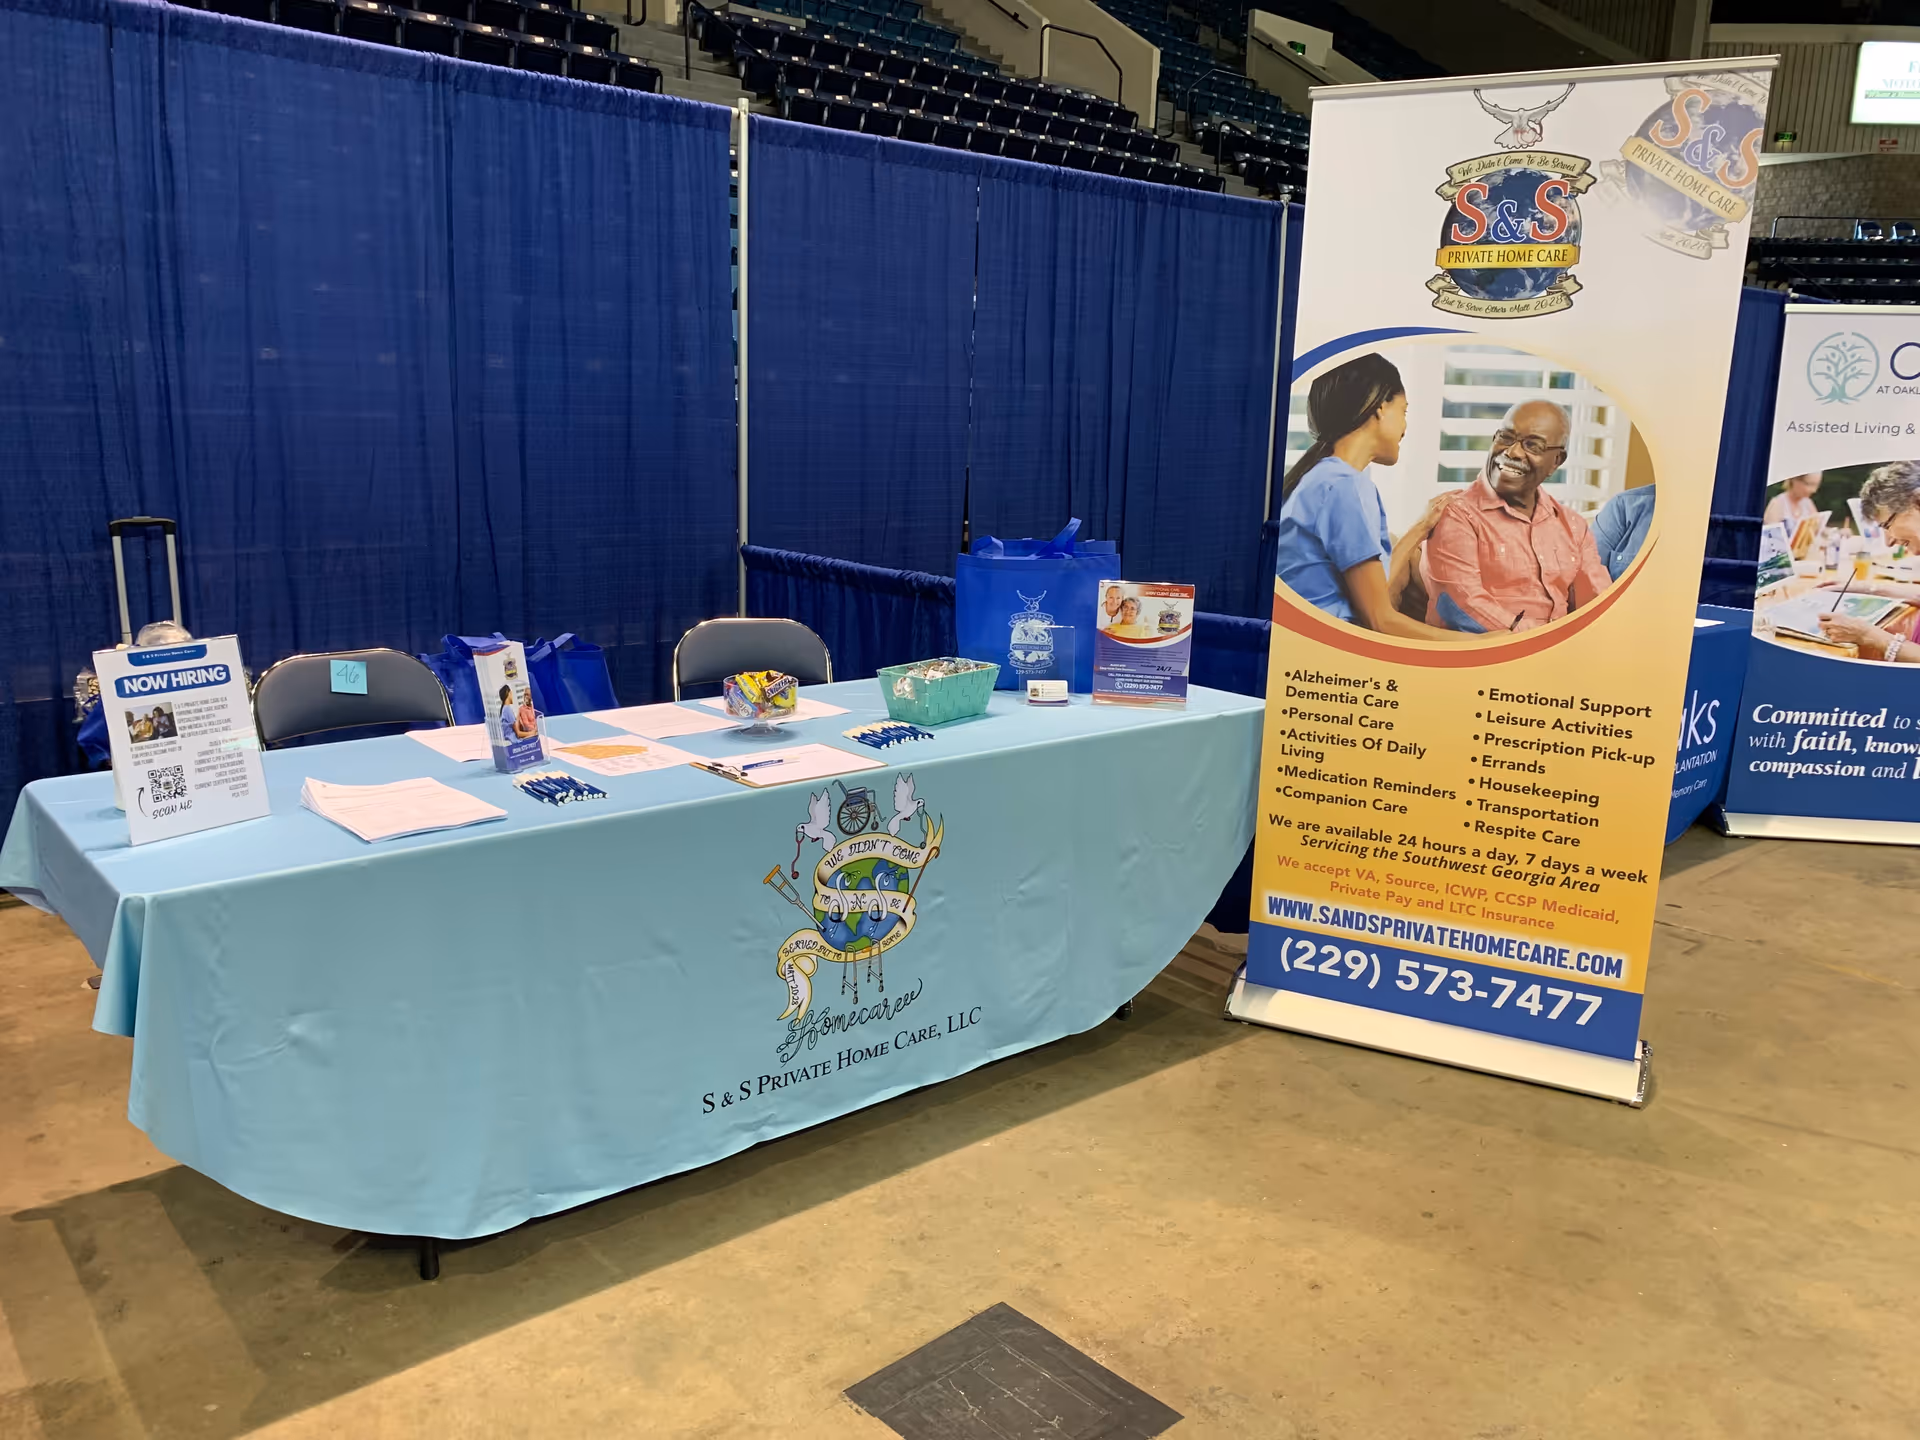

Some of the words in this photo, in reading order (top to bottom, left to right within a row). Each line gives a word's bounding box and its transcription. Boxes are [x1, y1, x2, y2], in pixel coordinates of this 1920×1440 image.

[1458, 166, 1473, 177] We
[1475, 157, 1501, 172] Didn't
[1503, 155, 1524, 167] Come
[1537, 156, 1549, 167] Be
[1551, 158, 1577, 172] Served
[1631, 144, 1675, 177] PRIVATE
[1673, 168, 1711, 198] HOME
[1707, 190, 1739, 215] CARE
[1447, 250, 1493, 264] PRIVATE
[1496, 249, 1533, 263] HOME
[1536, 248, 1568, 262] CARE
[1465, 302, 1483, 313] Serve
[1876, 386, 1891, 394] AT
[1786, 421, 1850, 433] Assisted
[1854, 422, 1900, 437] Living
[1905, 423, 1916, 435] &
[123, 674, 168, 694] NOW
[170, 666, 226, 688] HIRING
[1291, 670, 1380, 690] Alzheimer's
[1386, 679, 1398, 692] &
[1286, 685, 1358, 705] Dementia
[1363, 694, 1399, 709] Care
[1489, 688, 1574, 709] Emotional
[1580, 698, 1652, 718] Support
[1289, 707, 1353, 726] Personal
[1358, 715, 1394, 730] Care
[1487, 710, 1546, 728] Leisure
[1551, 718, 1632, 739] Activities
[1752, 704, 1888, 728] Committed
[1893, 715, 1911, 730] to
[1281, 744, 1324, 763] Living
[1287, 728, 1357, 748] Activities
[1362, 737, 1383, 751] Of
[1387, 740, 1427, 760] Daily
[1484, 733, 1585, 757] Prescription
[1592, 746, 1655, 768] Pick-up
[1749, 732, 1787, 748] with
[1786, 728, 1857, 755] faith,
[1864, 736, 1920, 755] know
[1482, 755, 1545, 774] Errands
[1674, 749, 1718, 774] LANTATION
[1749, 760, 1866, 778] compassion
[1872, 762, 1908, 779] and
[1284, 765, 1367, 787] Medication
[1373, 777, 1456, 800] Reminders
[1480, 776, 1599, 808] Housekeeping
[152, 804, 177, 820] SCAN
[179, 799, 193, 812] ME
[1283, 786, 1367, 808] Companion
[1372, 799, 1408, 814] Care
[1477, 798, 1599, 827] Transportation
[1475, 820, 1536, 840] Respite
[1542, 830, 1580, 847] Care
[824, 849, 844, 868] WE
[848, 839, 891, 856] DIDN'T
[892, 844, 920, 864] COME
[1269, 813, 1292, 828] We
[1297, 821, 1320, 832] are
[1325, 826, 1392, 843] available
[1398, 834, 1417, 847] 24
[1422, 837, 1466, 855] hours
[1472, 849, 1480, 857] a
[1486, 847, 1518, 866] day,
[1526, 853, 1536, 865] 7
[1541, 856, 1579, 875] days
[1585, 866, 1595, 875] a
[1601, 868, 1648, 883] week
[1300, 835, 1369, 859] Servicing
[1373, 846, 1398, 860] the
[1402, 851, 1487, 875] Southwest
[1492, 865, 1556, 887] Georgia
[1559, 876, 1600, 893] Area
[1278, 855, 1299, 868] We
[1304, 863, 1350, 878] accept
[1356, 868, 1380, 884] VA,
[1386, 873, 1439, 893] Source,
[1446, 883, 1488, 902] ICWP,
[1495, 892, 1536, 907] CCSP
[1542, 899, 1619, 924] Medicaid,
[1330, 881, 1380, 899] Private
[1386, 891, 1412, 907] Pay
[1417, 899, 1444, 910] and
[1450, 902, 1476, 916] LTC
[1482, 907, 1554, 929] Insurance
[1268, 896, 1623, 979] WWW.SANDSPRIVATEHOMECARE.COM
[1281, 936, 1381, 990] (229)
[1395, 959, 1602, 1026] 573-7477
[702, 1092, 716, 1115] S
[721, 1092, 734, 1108] &
[739, 1080, 752, 1102] S
[947, 1006, 983, 1034] LLC
